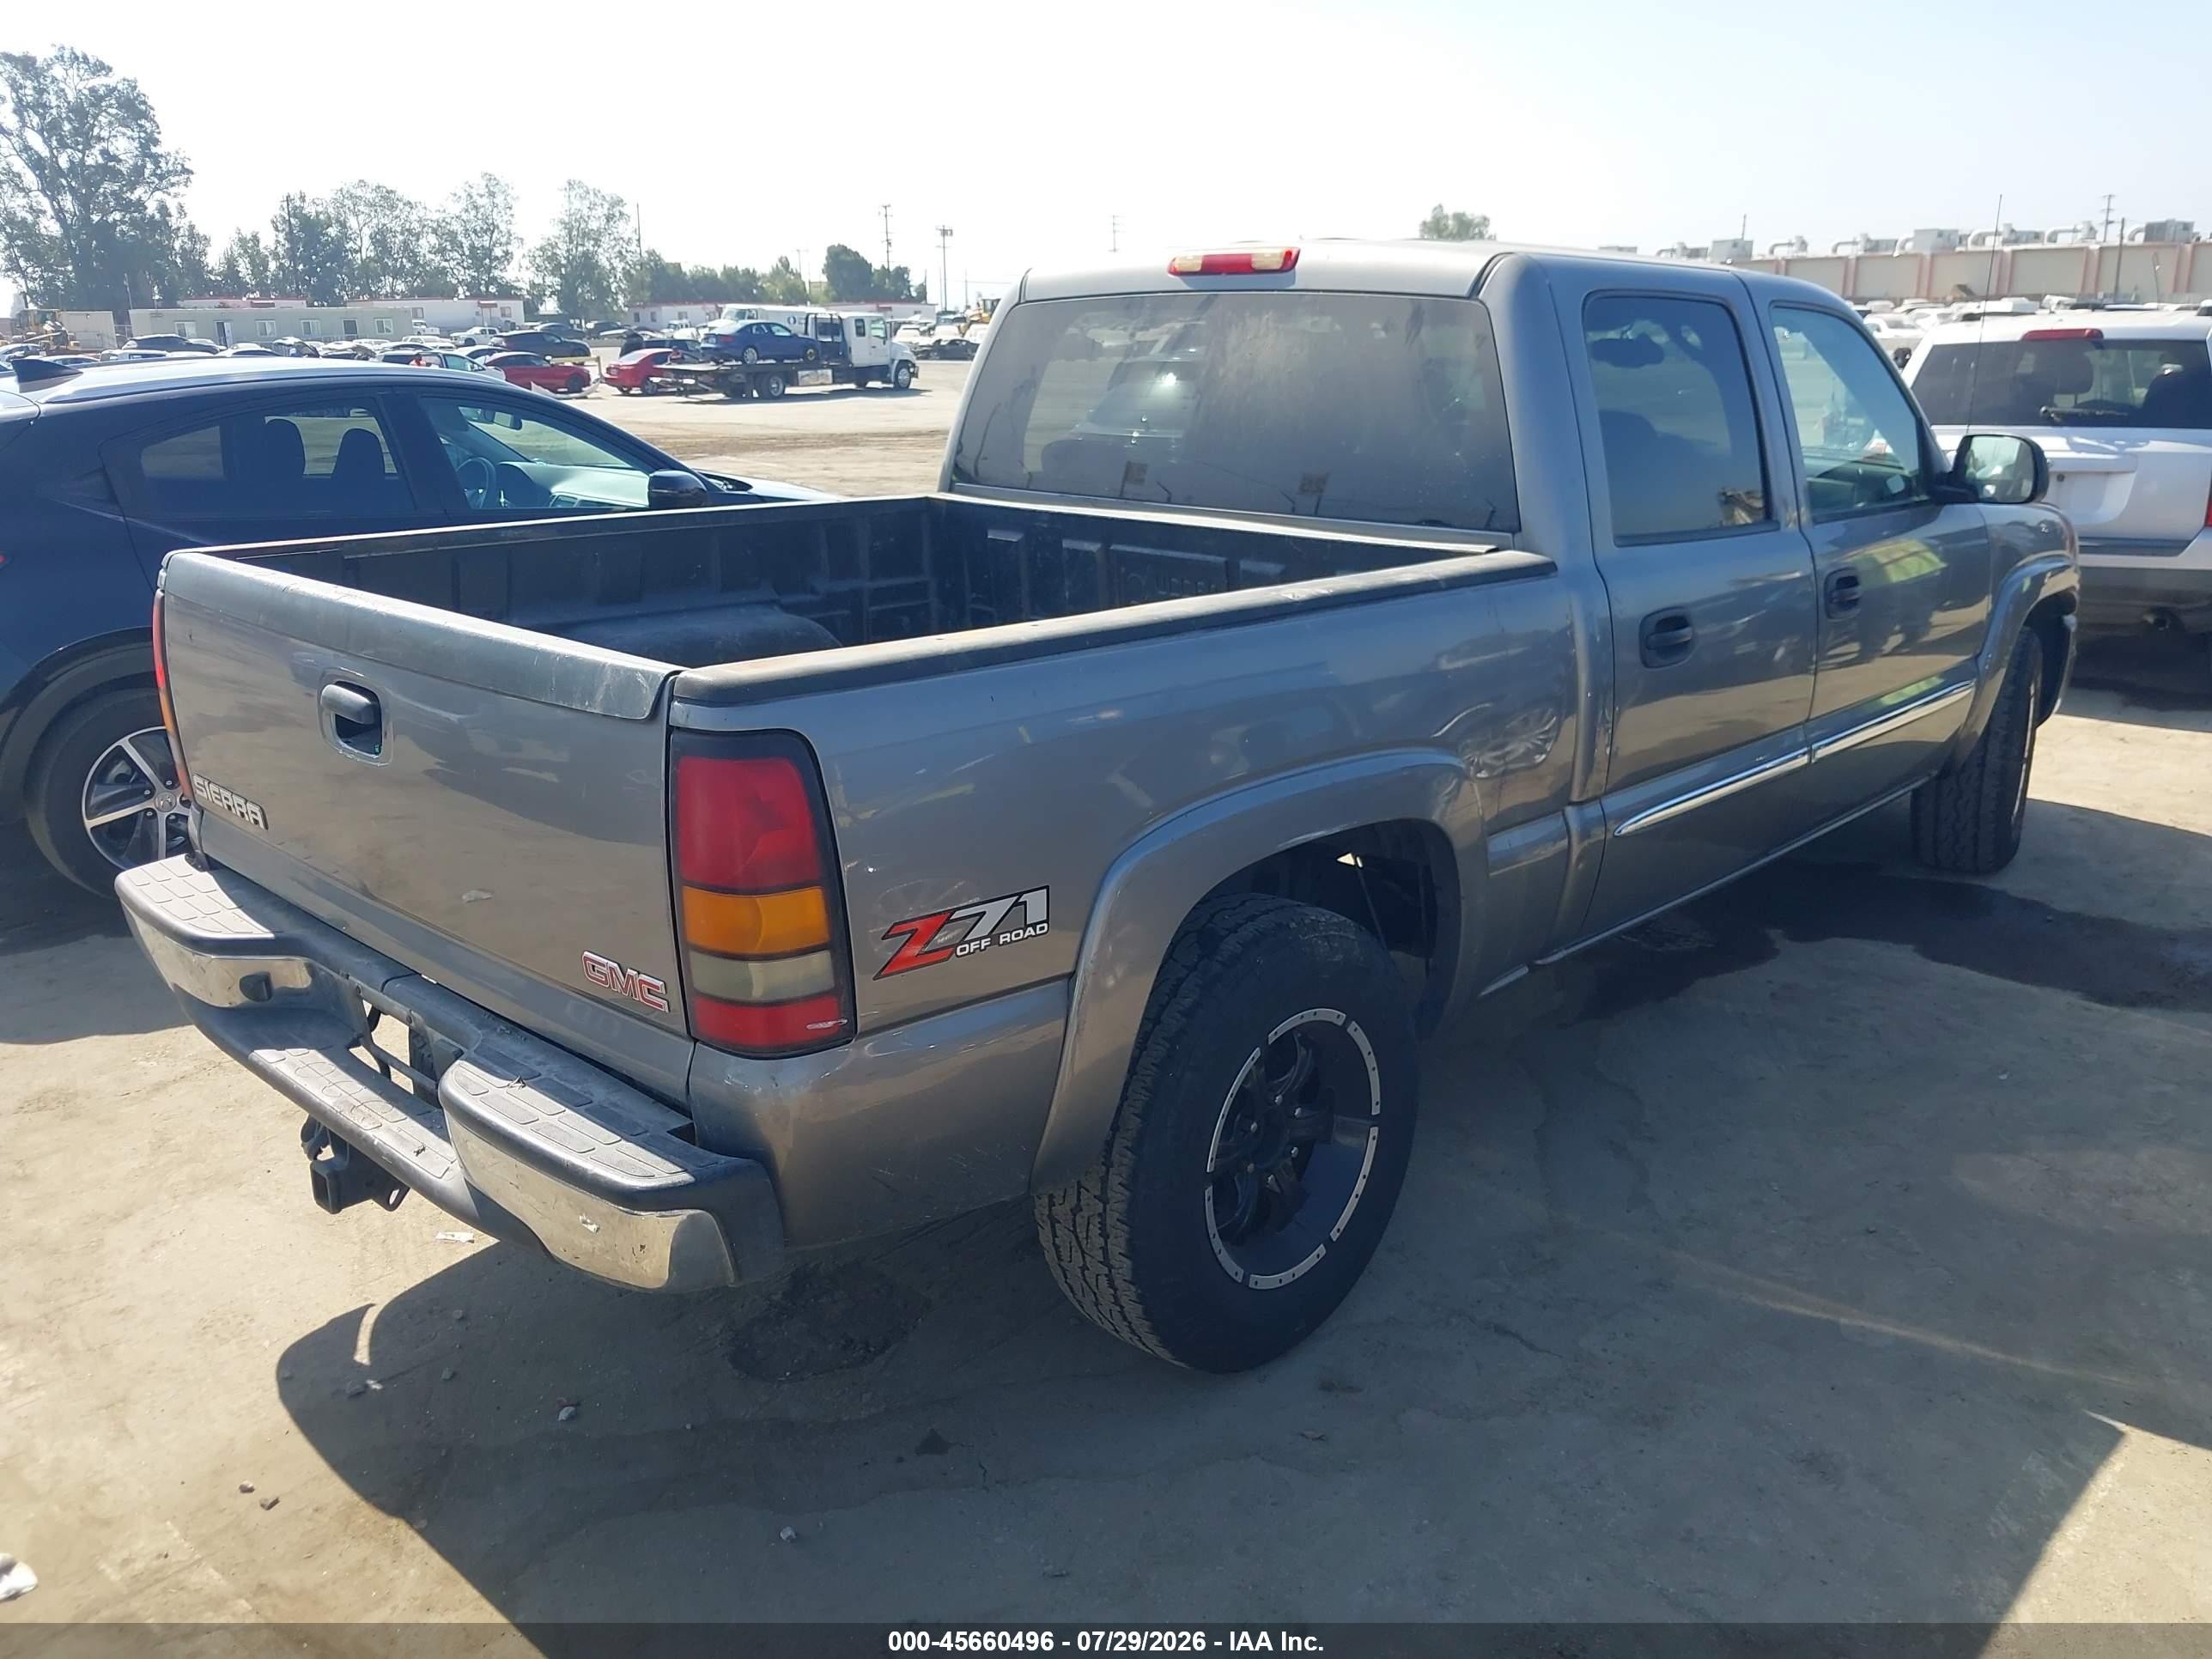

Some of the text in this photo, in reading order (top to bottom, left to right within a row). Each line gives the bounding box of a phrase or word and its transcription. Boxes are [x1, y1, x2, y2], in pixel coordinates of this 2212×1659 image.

[192, 774, 265, 830] SIERRA
[873, 886, 1049, 980] Z71
[956, 922, 1048, 957] OFF ROAD
[582, 950, 669, 1012] GMC
